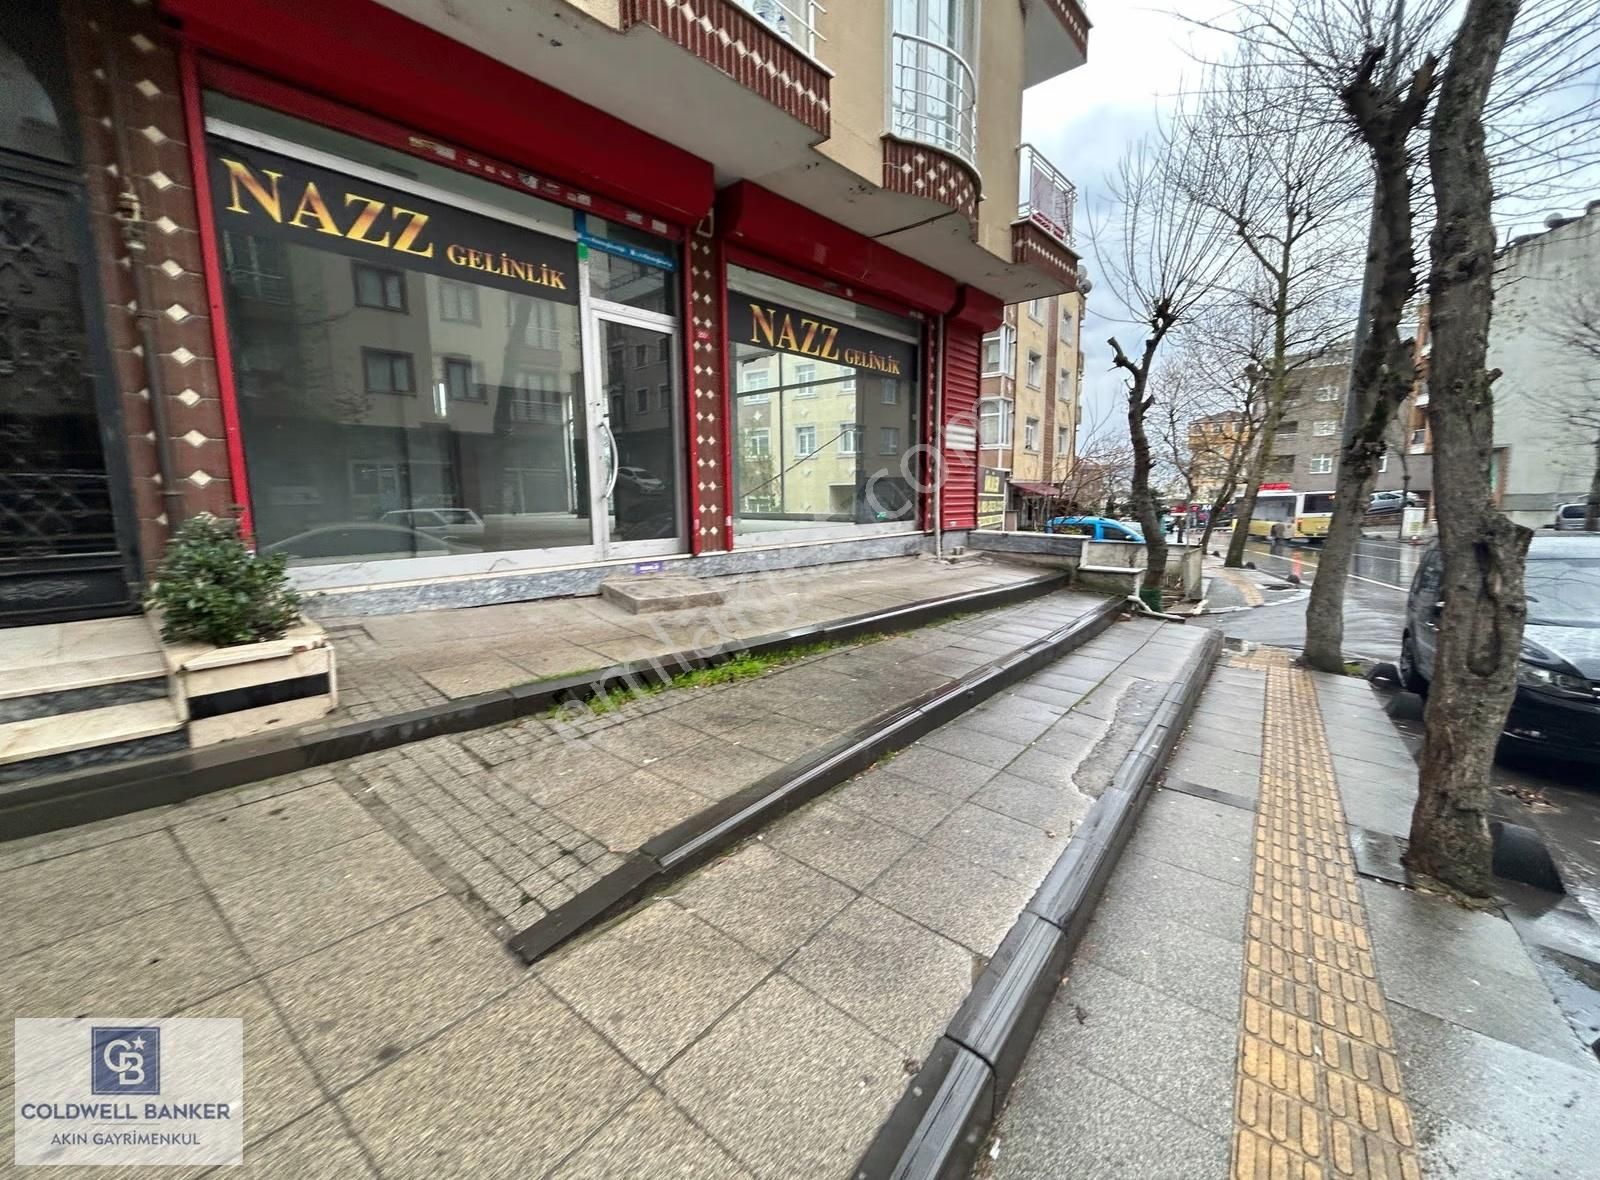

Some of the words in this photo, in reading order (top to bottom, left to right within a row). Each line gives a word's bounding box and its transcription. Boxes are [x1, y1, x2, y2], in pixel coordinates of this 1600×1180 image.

[221, 158, 434, 259] NAZZ
[446, 244, 566, 290] GELİNLİK
[749, 303, 840, 361] NAZZ
[844, 349, 901, 375] GELİNLİK
